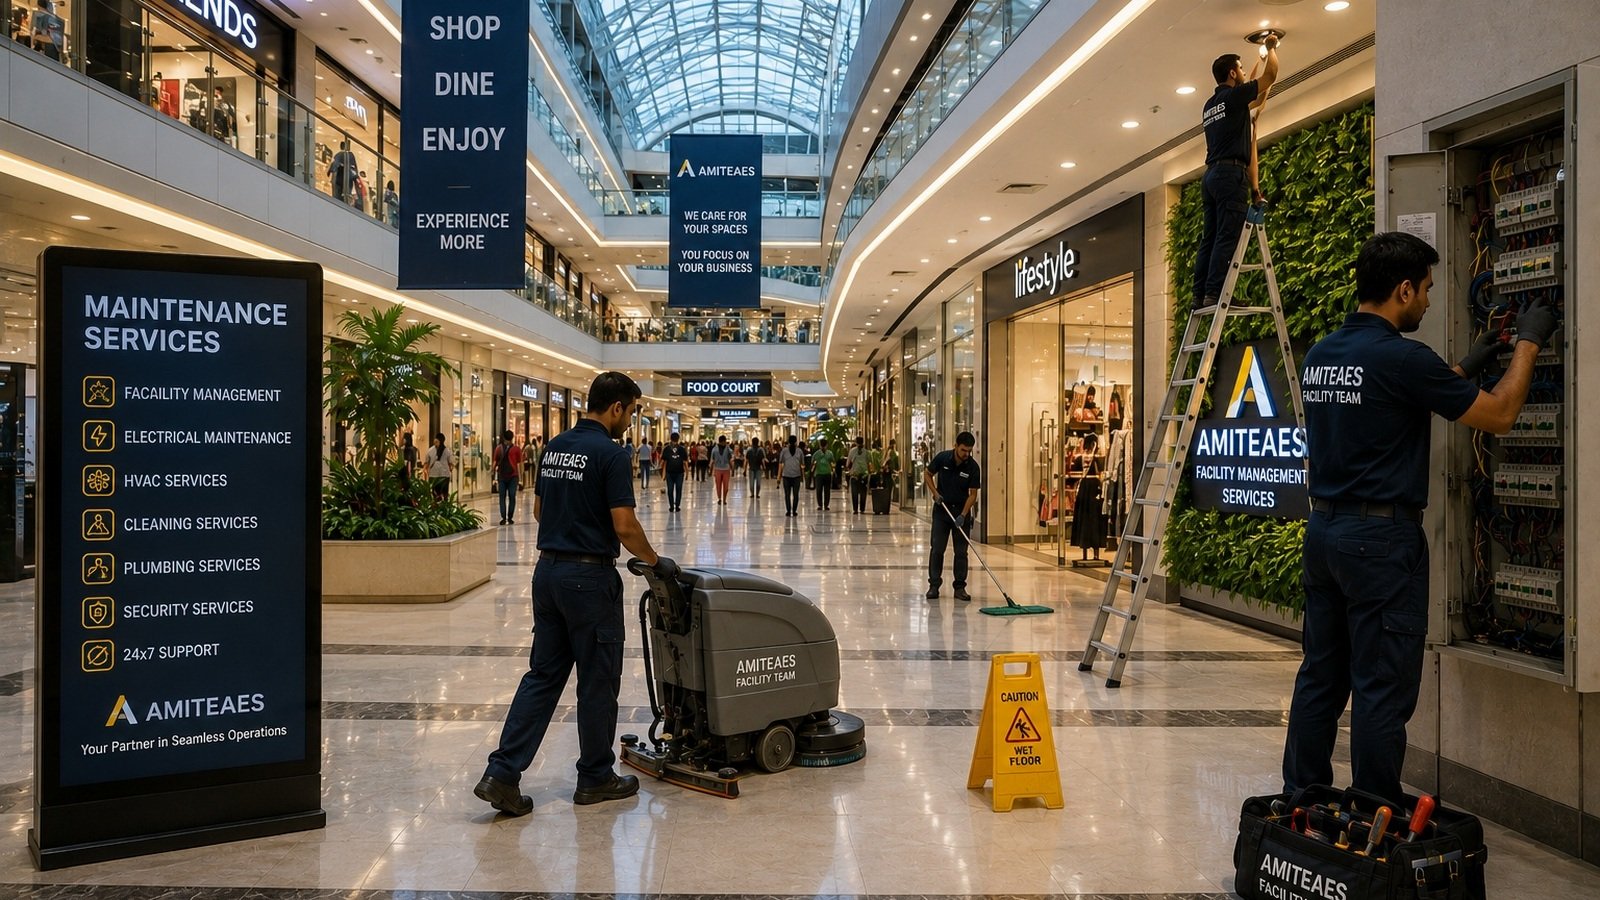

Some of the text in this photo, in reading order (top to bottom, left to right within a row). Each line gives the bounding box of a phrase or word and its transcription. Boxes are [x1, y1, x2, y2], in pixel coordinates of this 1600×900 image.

[429, 15, 501, 41] SHOP
[435, 71, 495, 96] DINE
[422, 126, 506, 152] ENJOY
[698, 165, 755, 177] AMITEAES
[416, 213, 510, 229] EXPERIENCE
[684, 210, 747, 221] WE CARE FOR
[683, 224, 748, 235] YOUR SPACES
[440, 234, 485, 250] MORE
[681, 249, 750, 260] YOU FOCUS ON
[677, 262, 753, 273] YOUR BUSINESS
[1015, 241, 1074, 298] lifestyle
[84, 294, 288, 326] MAINTENANCE
[84, 326, 221, 354] SERVICES
[1301, 365, 1364, 387] AMITEAES
[193, 387, 282, 402] MANAGEMENT
[686, 381, 761, 393] FOOD COURT
[1302, 389, 1361, 405] FACILITY TEAM
[124, 430, 292, 445] ELECTRICAL MAINTENANCE
[1196, 427, 1306, 458] AMITEAES
[541, 451, 588, 469] AMITEAES
[124, 473, 228, 488] HVAC SERVICES
[565, 469, 583, 481] TEAM
[1196, 465, 1307, 484] FACILITY MANAGEMENT
[1222, 487, 1275, 508] SERVICES
[124, 515, 258, 532] CLEANING SERVICES
[124, 557, 261, 575] PLUMBING SERVICES
[123, 600, 254, 619] SECURITY SERVICES
[123, 643, 220, 661] 24x7 SUPPORT
[736, 654, 797, 675] AMITEAES
[735, 670, 796, 688] FACILITY TEAM
[1000, 691, 1039, 703] CAUTION
[145, 693, 265, 722] AMITEAES
[81, 725, 287, 756] Your Partner in Seamless Operations
[1013, 745, 1033, 756] WET
[1009, 755, 1042, 766] FLOOR
[1260, 853, 1348, 900] AMITEAES
[1259, 877, 1308, 900] FACILIT
